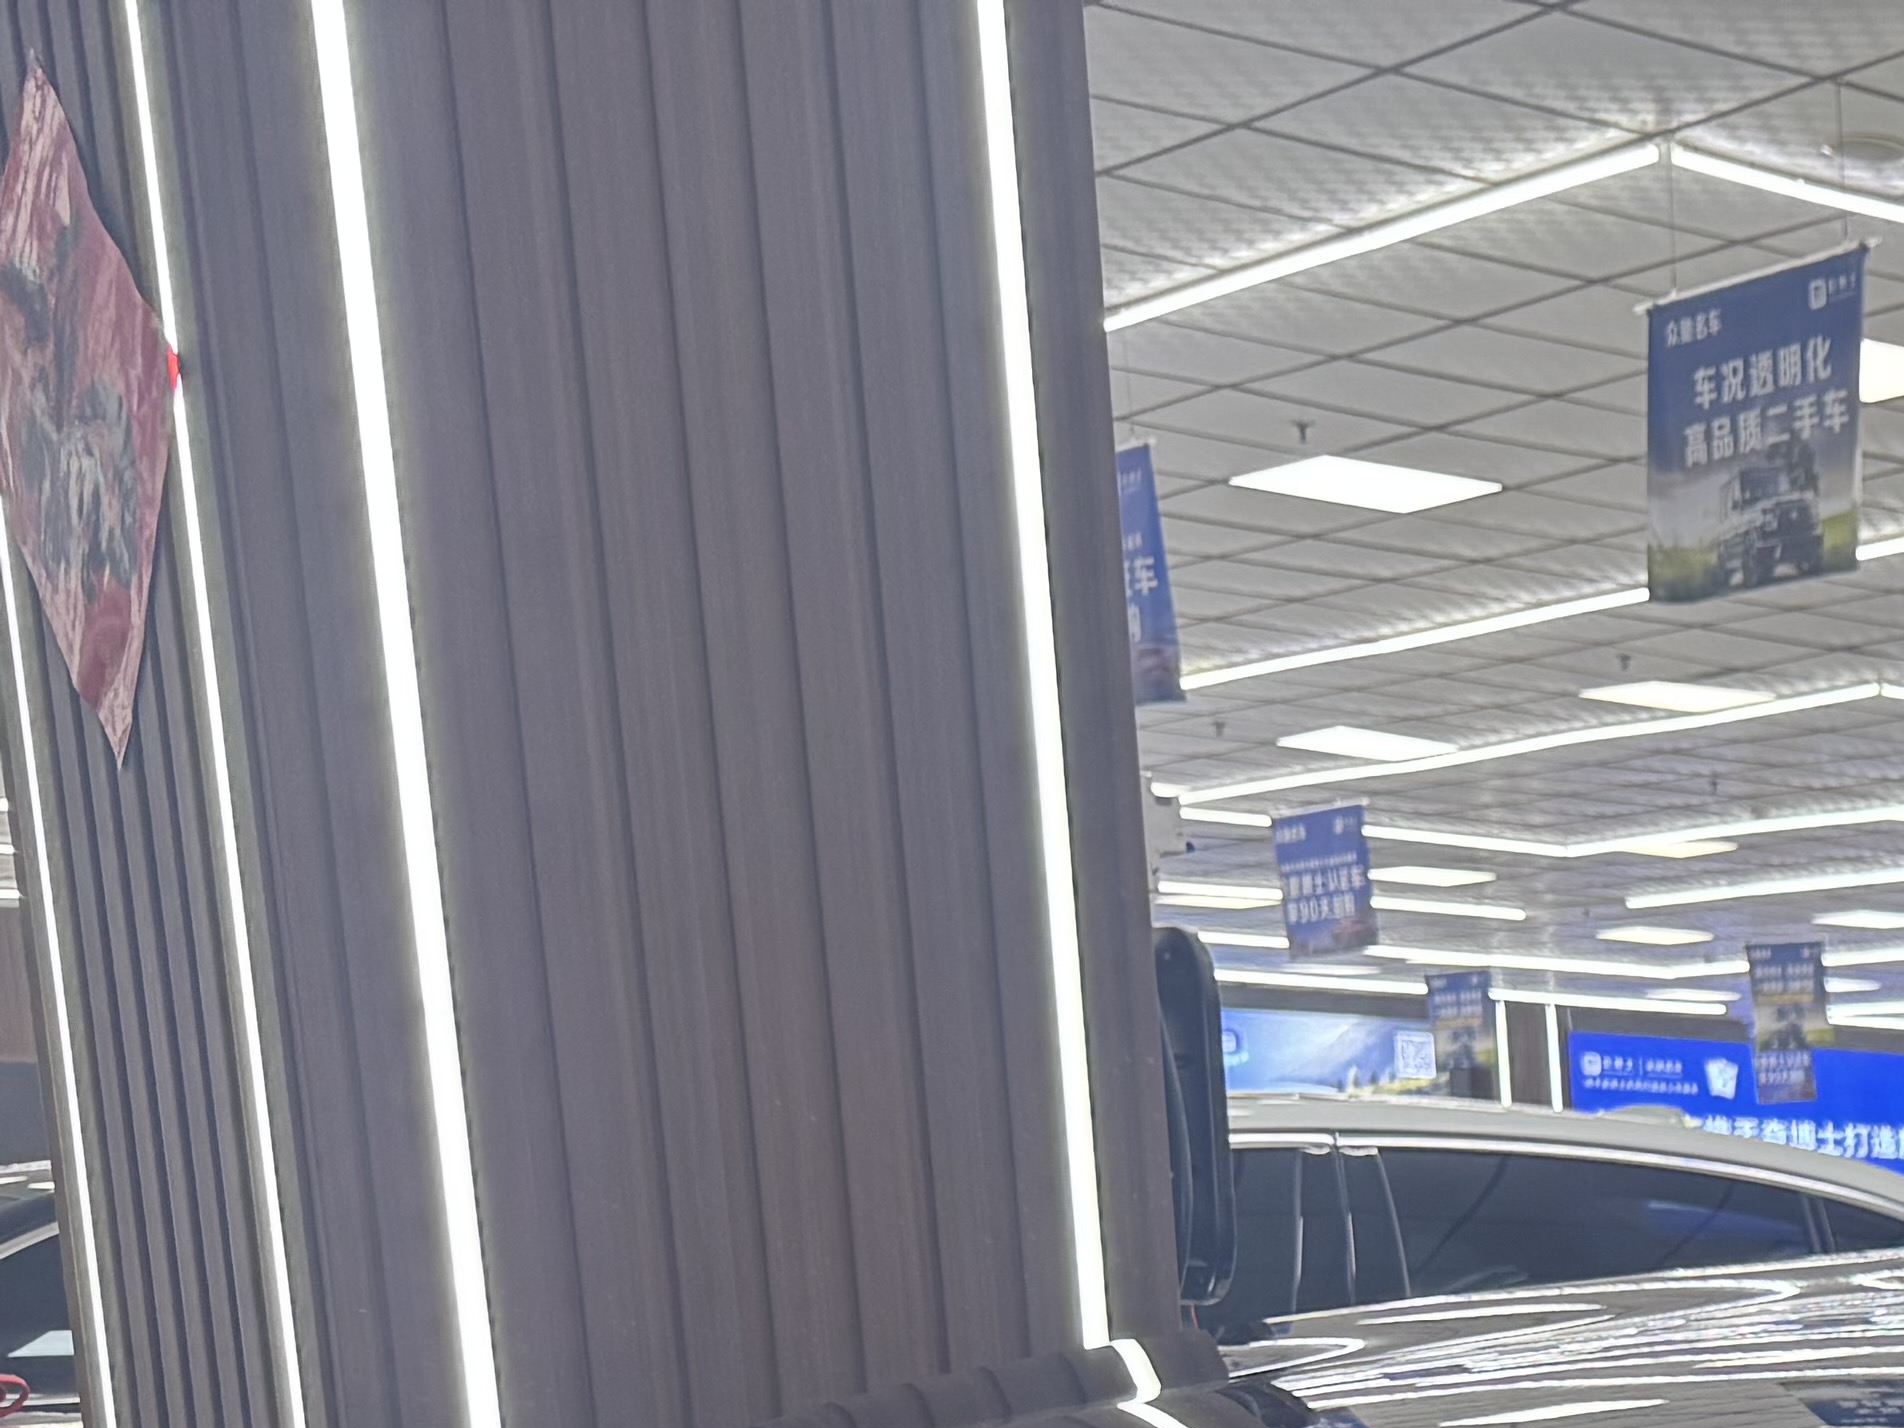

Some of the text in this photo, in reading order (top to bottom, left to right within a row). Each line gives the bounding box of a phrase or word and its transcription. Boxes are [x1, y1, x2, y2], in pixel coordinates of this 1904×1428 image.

[1694, 335, 1832, 410] 车况透明化
[1684, 389, 1850, 468] 高品质二手车
